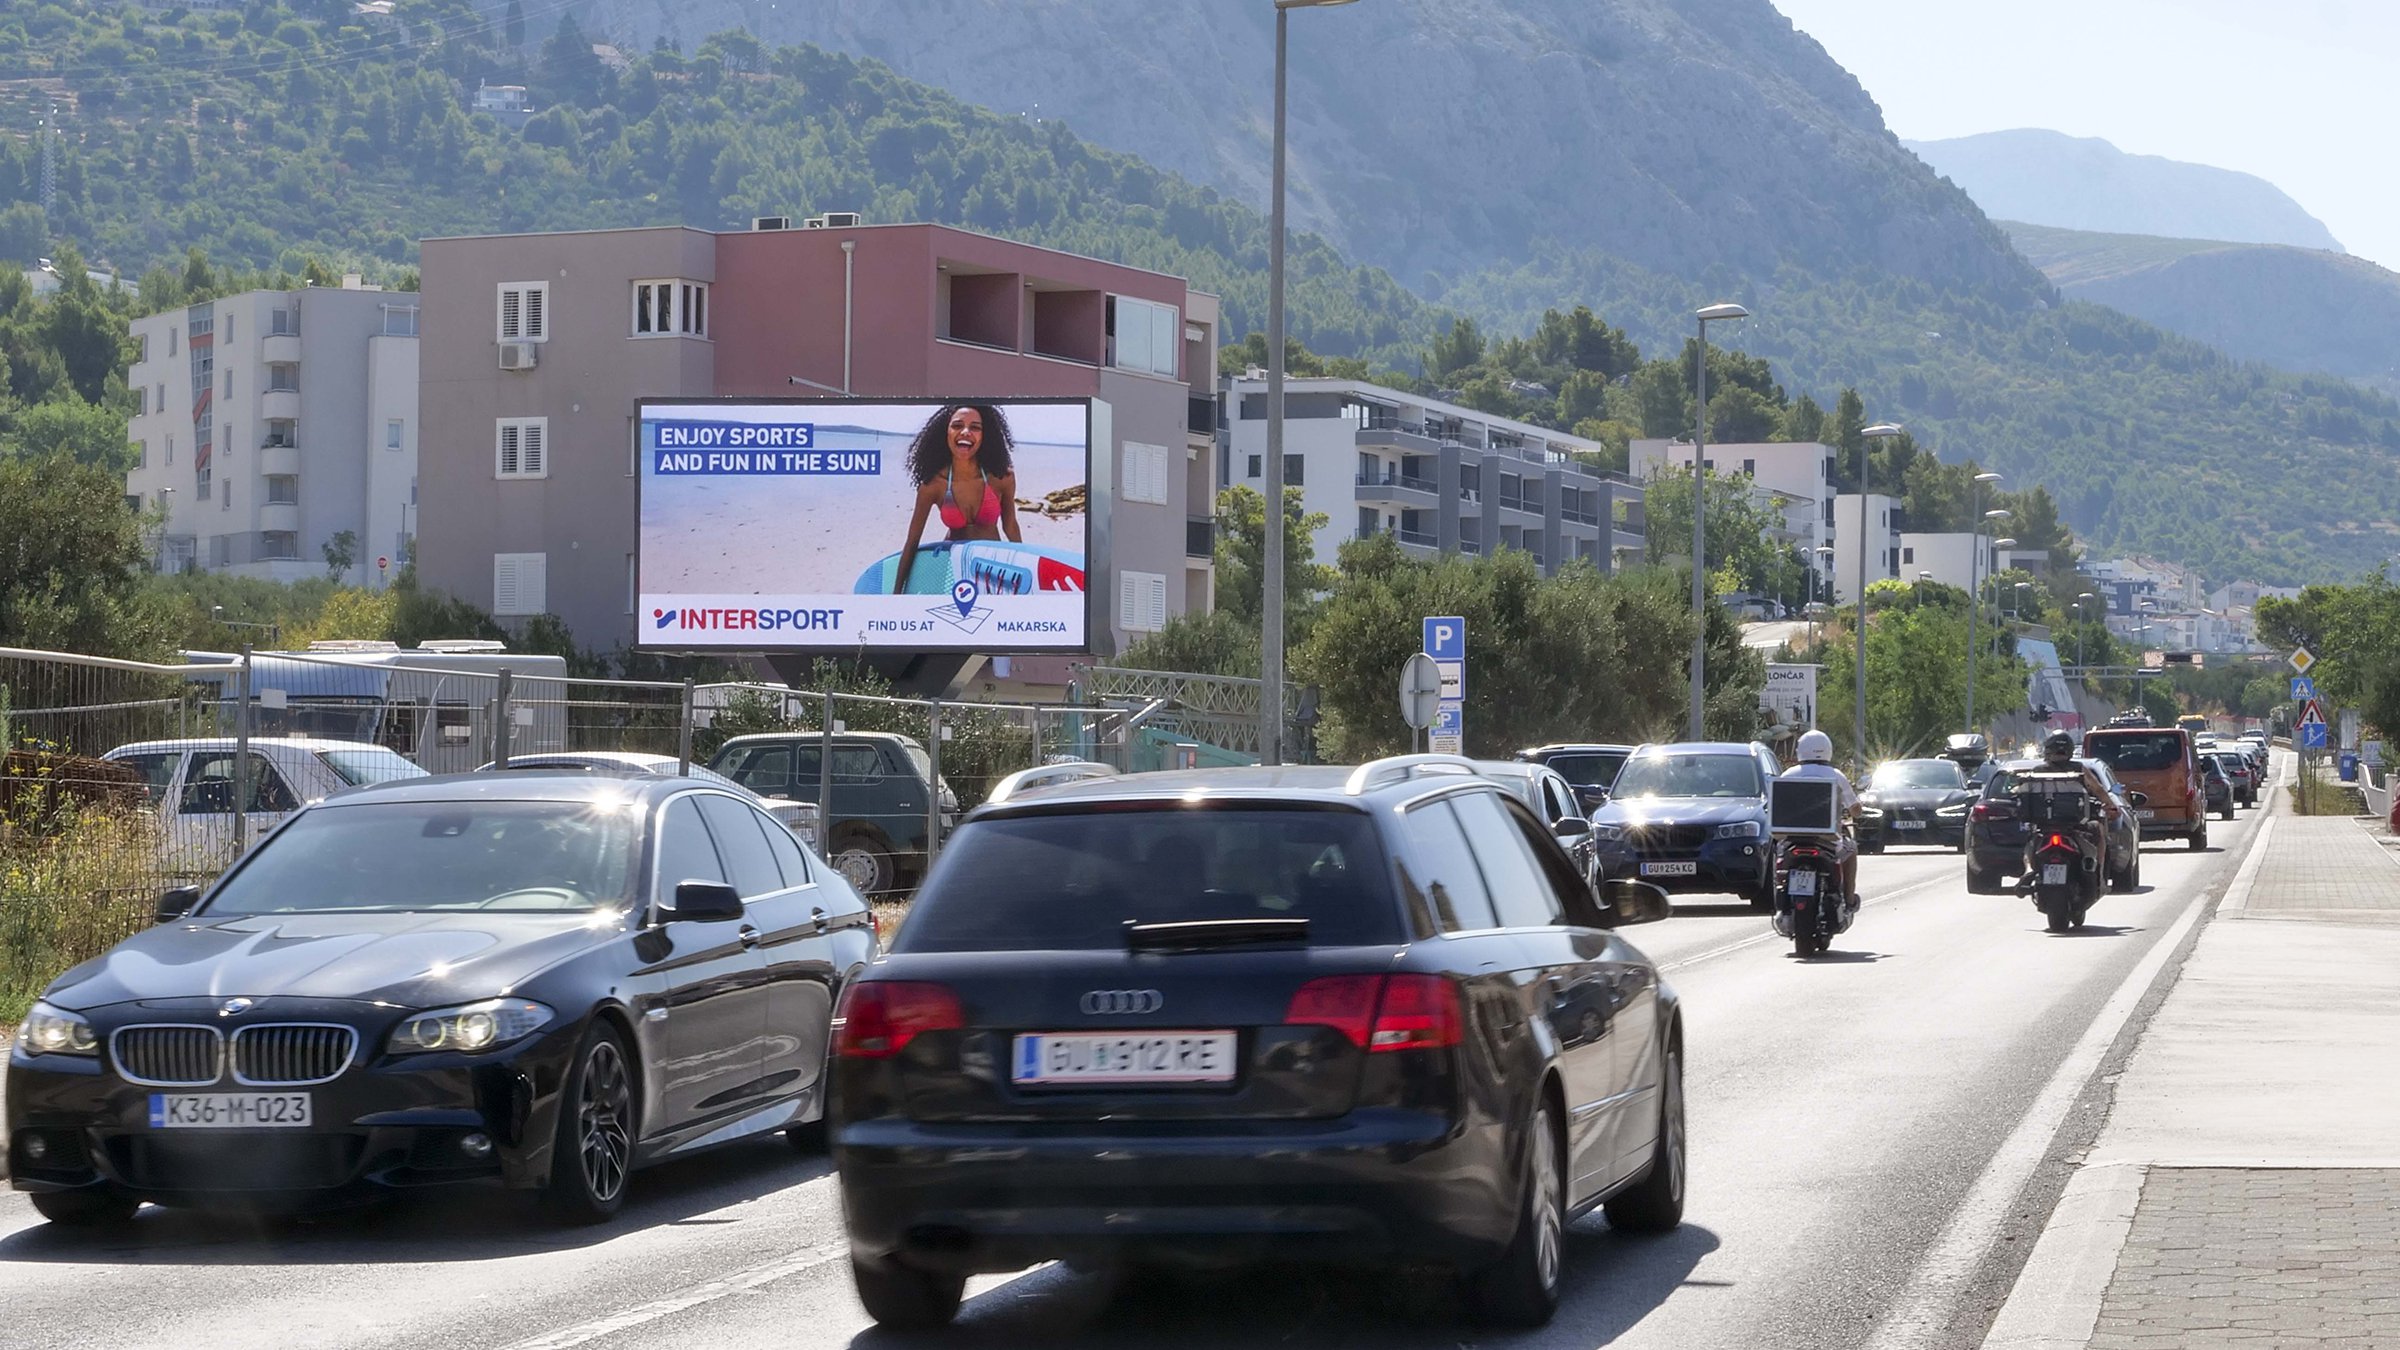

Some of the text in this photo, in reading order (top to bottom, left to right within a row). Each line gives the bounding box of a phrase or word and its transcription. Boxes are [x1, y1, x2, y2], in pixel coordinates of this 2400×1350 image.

[660, 427, 809, 446] ENJOY SPORTS
[658, 453, 877, 472] AND FUN IN THE SUN!
[680, 608, 844, 630] INTERSPORT
[868, 620, 935, 631] FIND US AT
[997, 621, 1067, 632] MAKARSKA
[1435, 625, 1453, 651] P
[1768, 670, 1805, 680] LONČAR
[1440, 712, 1452, 728] P
[167, 1096, 306, 1124] K36-M-023
